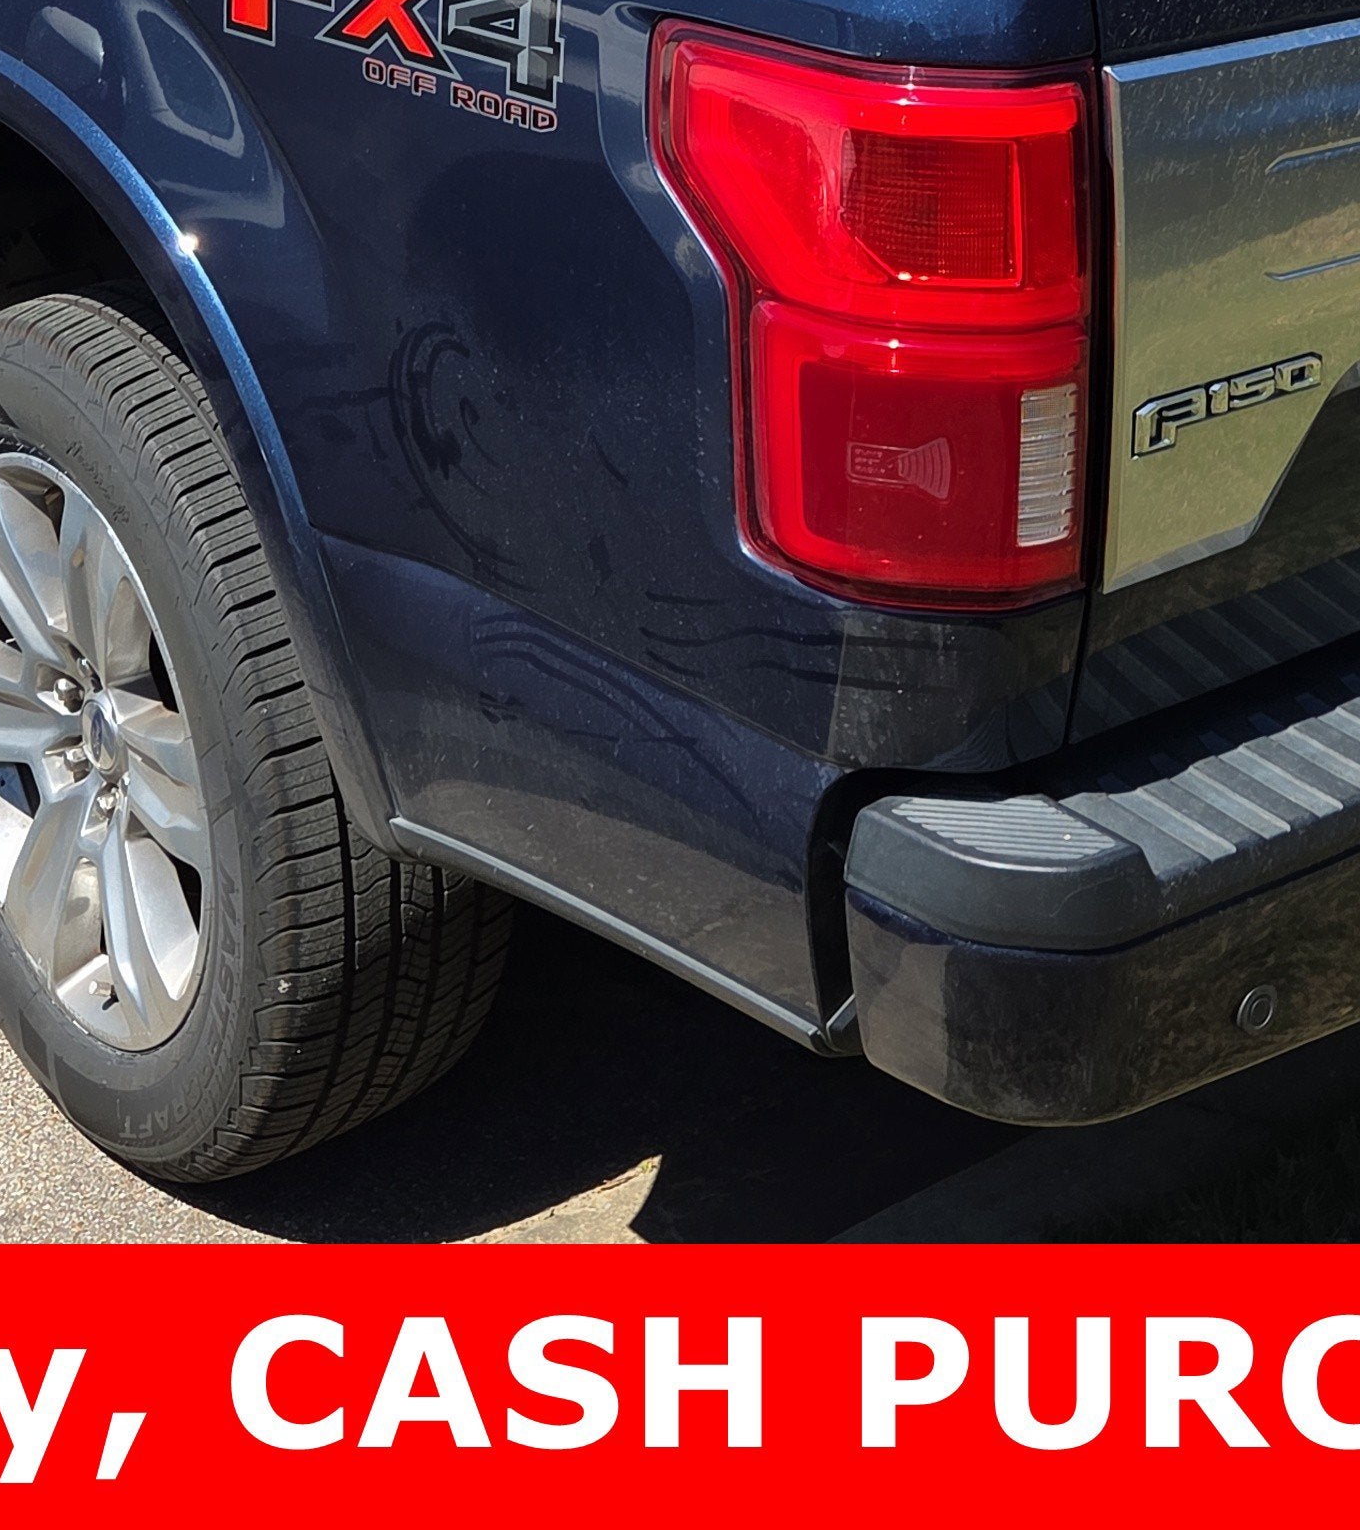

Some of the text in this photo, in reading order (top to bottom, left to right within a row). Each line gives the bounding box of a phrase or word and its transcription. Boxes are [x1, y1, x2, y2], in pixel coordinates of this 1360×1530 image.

[362, 56, 558, 133] OFF ROAD
[1131, 351, 1324, 461] F150
